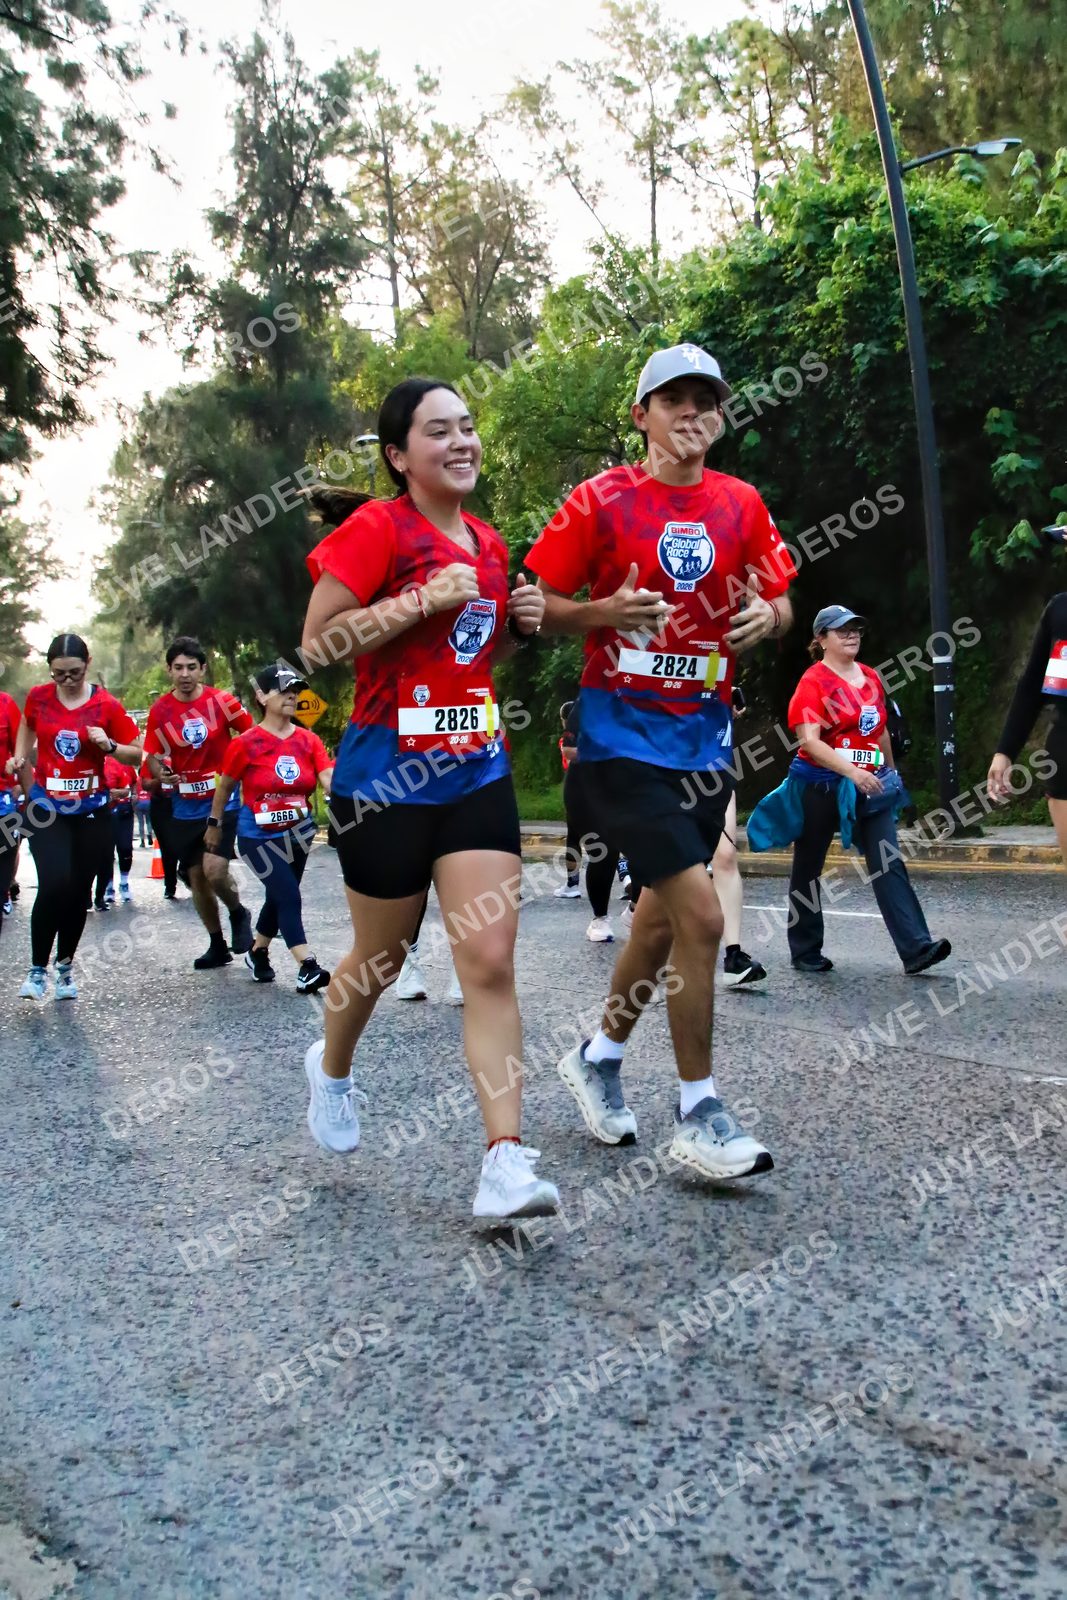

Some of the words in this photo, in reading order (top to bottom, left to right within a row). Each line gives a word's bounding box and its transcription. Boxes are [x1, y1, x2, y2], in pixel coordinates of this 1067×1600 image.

[671, 527, 700, 535] BIMBO
[672, 538, 700, 550] Global
[667, 546, 689, 558] Race
[676, 582, 693, 591] 2026
[471, 604, 492, 613] BIMBO
[652, 654, 698, 679] 2824
[434, 707, 479, 732] 2826
[853, 750, 872, 762] 1879
[63, 779, 85, 790] 1622
[190, 781, 209, 792] 1621
[270, 810, 294, 822] 2666
